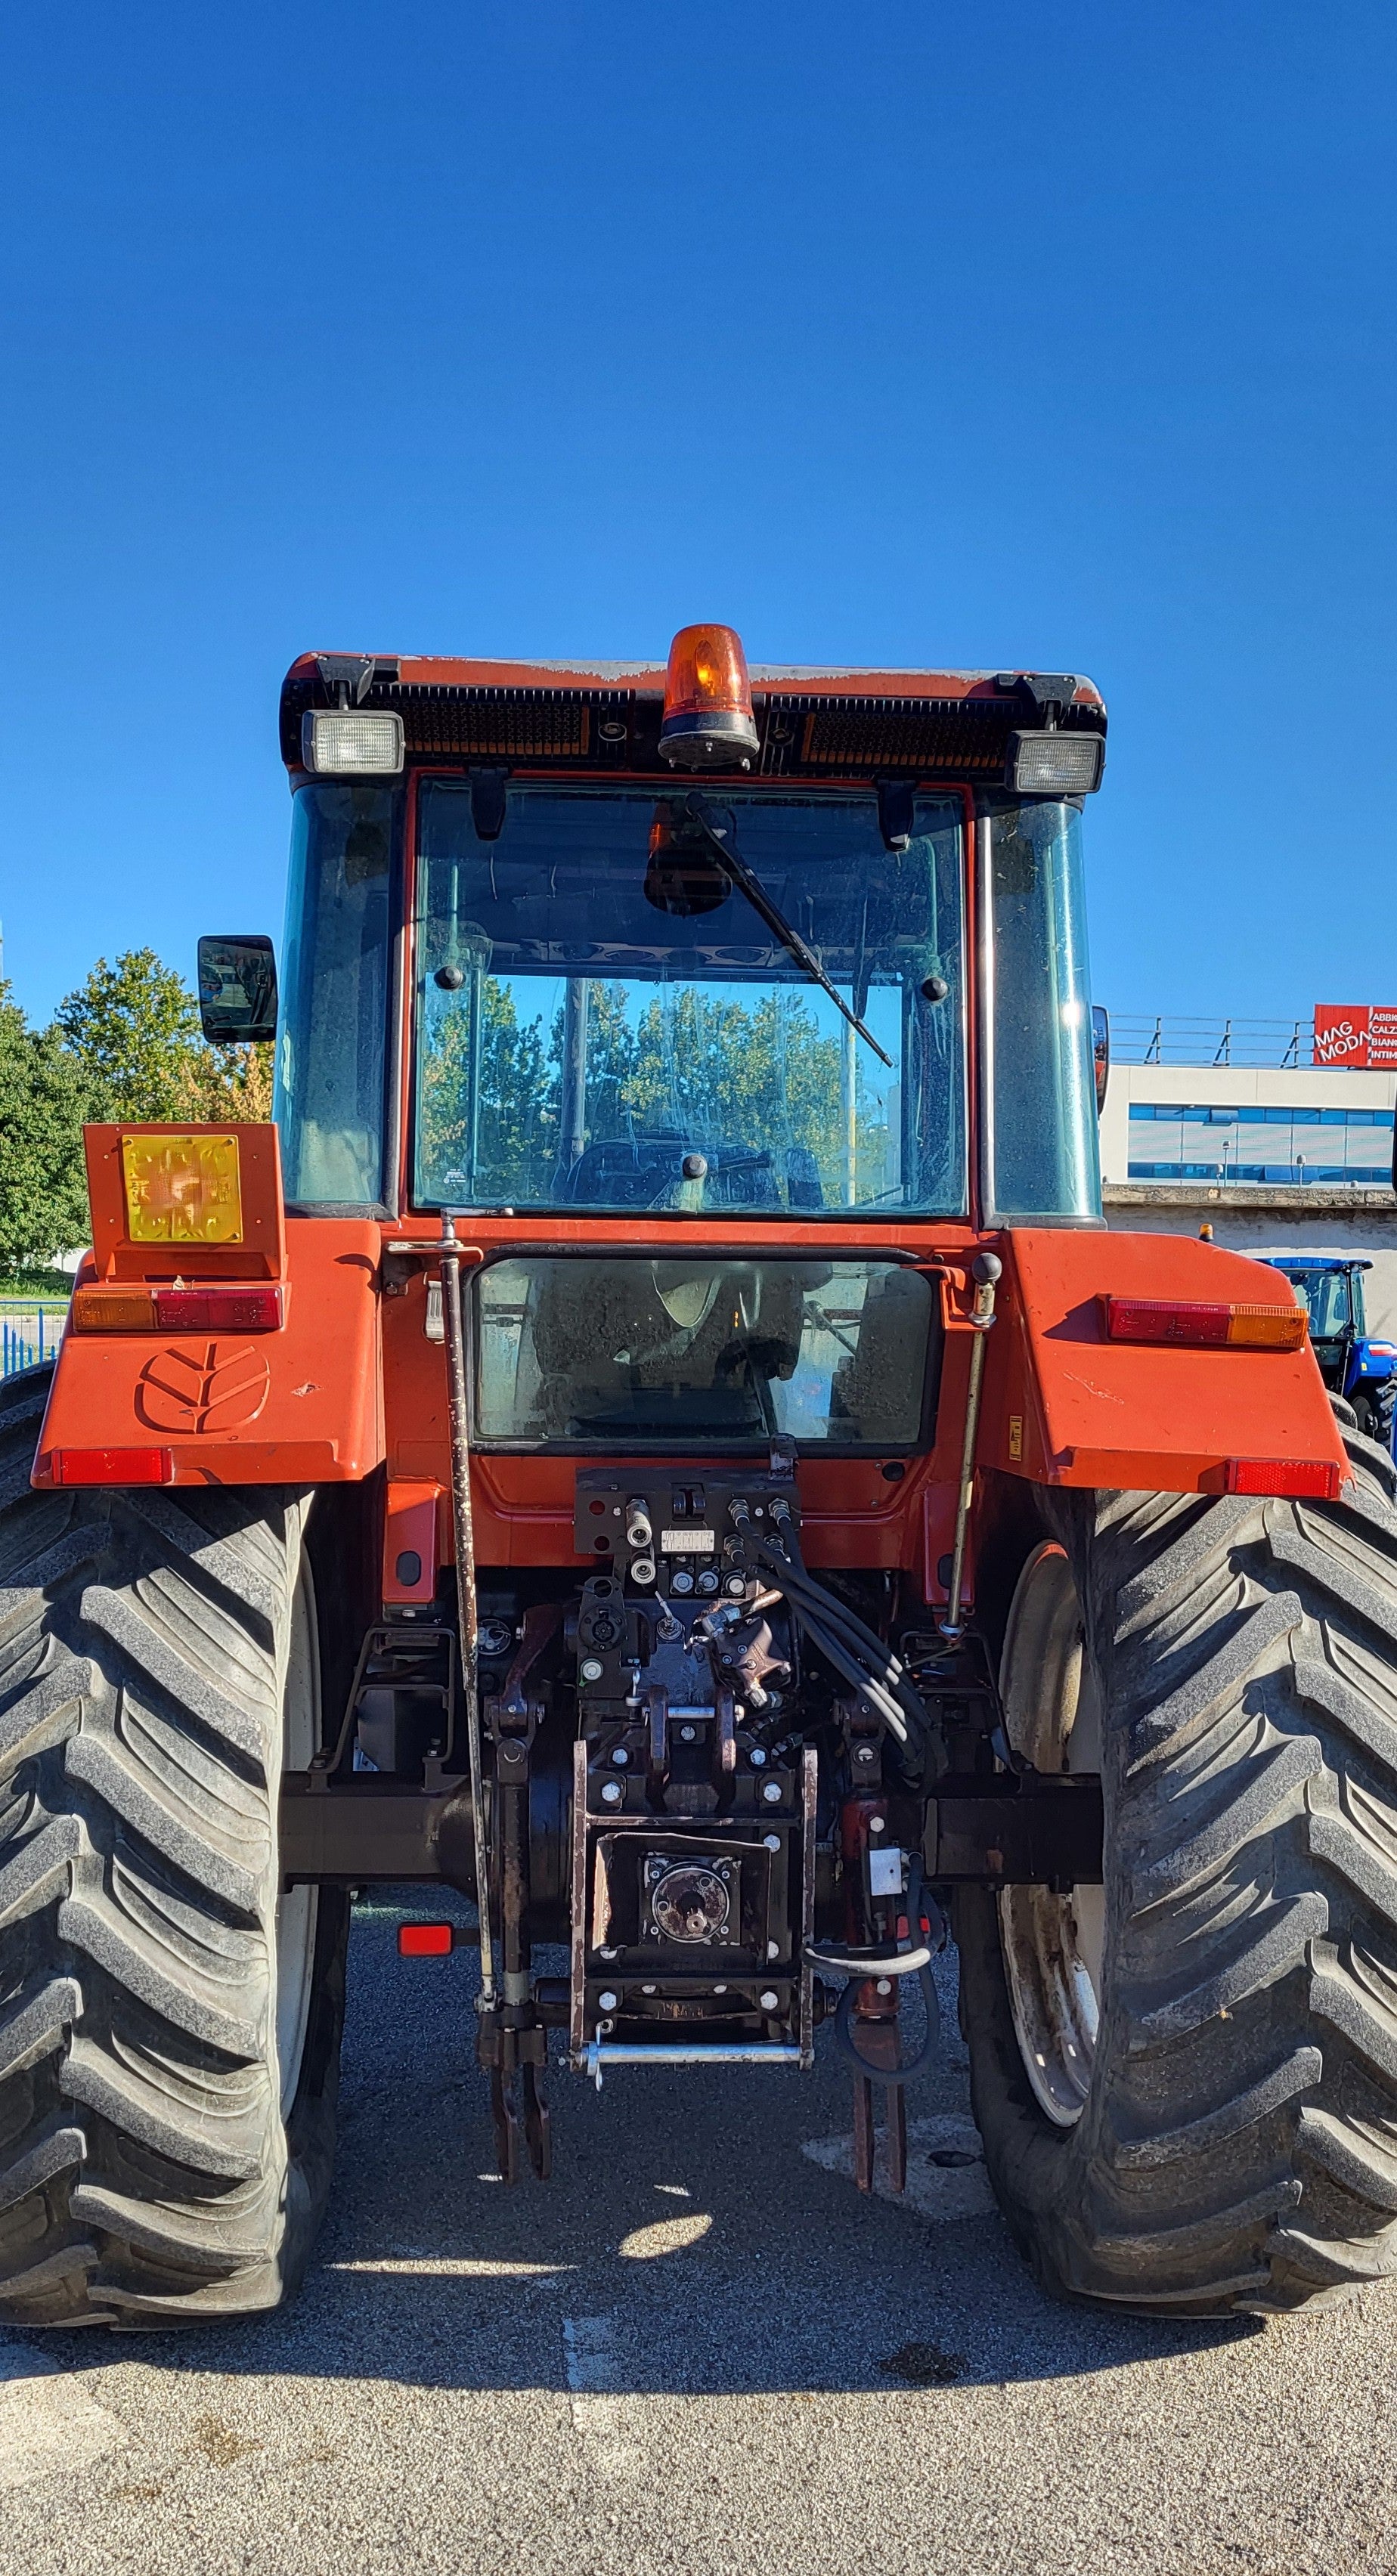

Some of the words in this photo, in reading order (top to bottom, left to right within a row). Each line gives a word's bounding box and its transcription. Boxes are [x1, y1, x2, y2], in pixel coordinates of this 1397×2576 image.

[1315, 1021, 1352, 1048] MAG
[1371, 1026, 1397, 1035] CALZ
[1320, 1031, 1371, 1062] MODA
